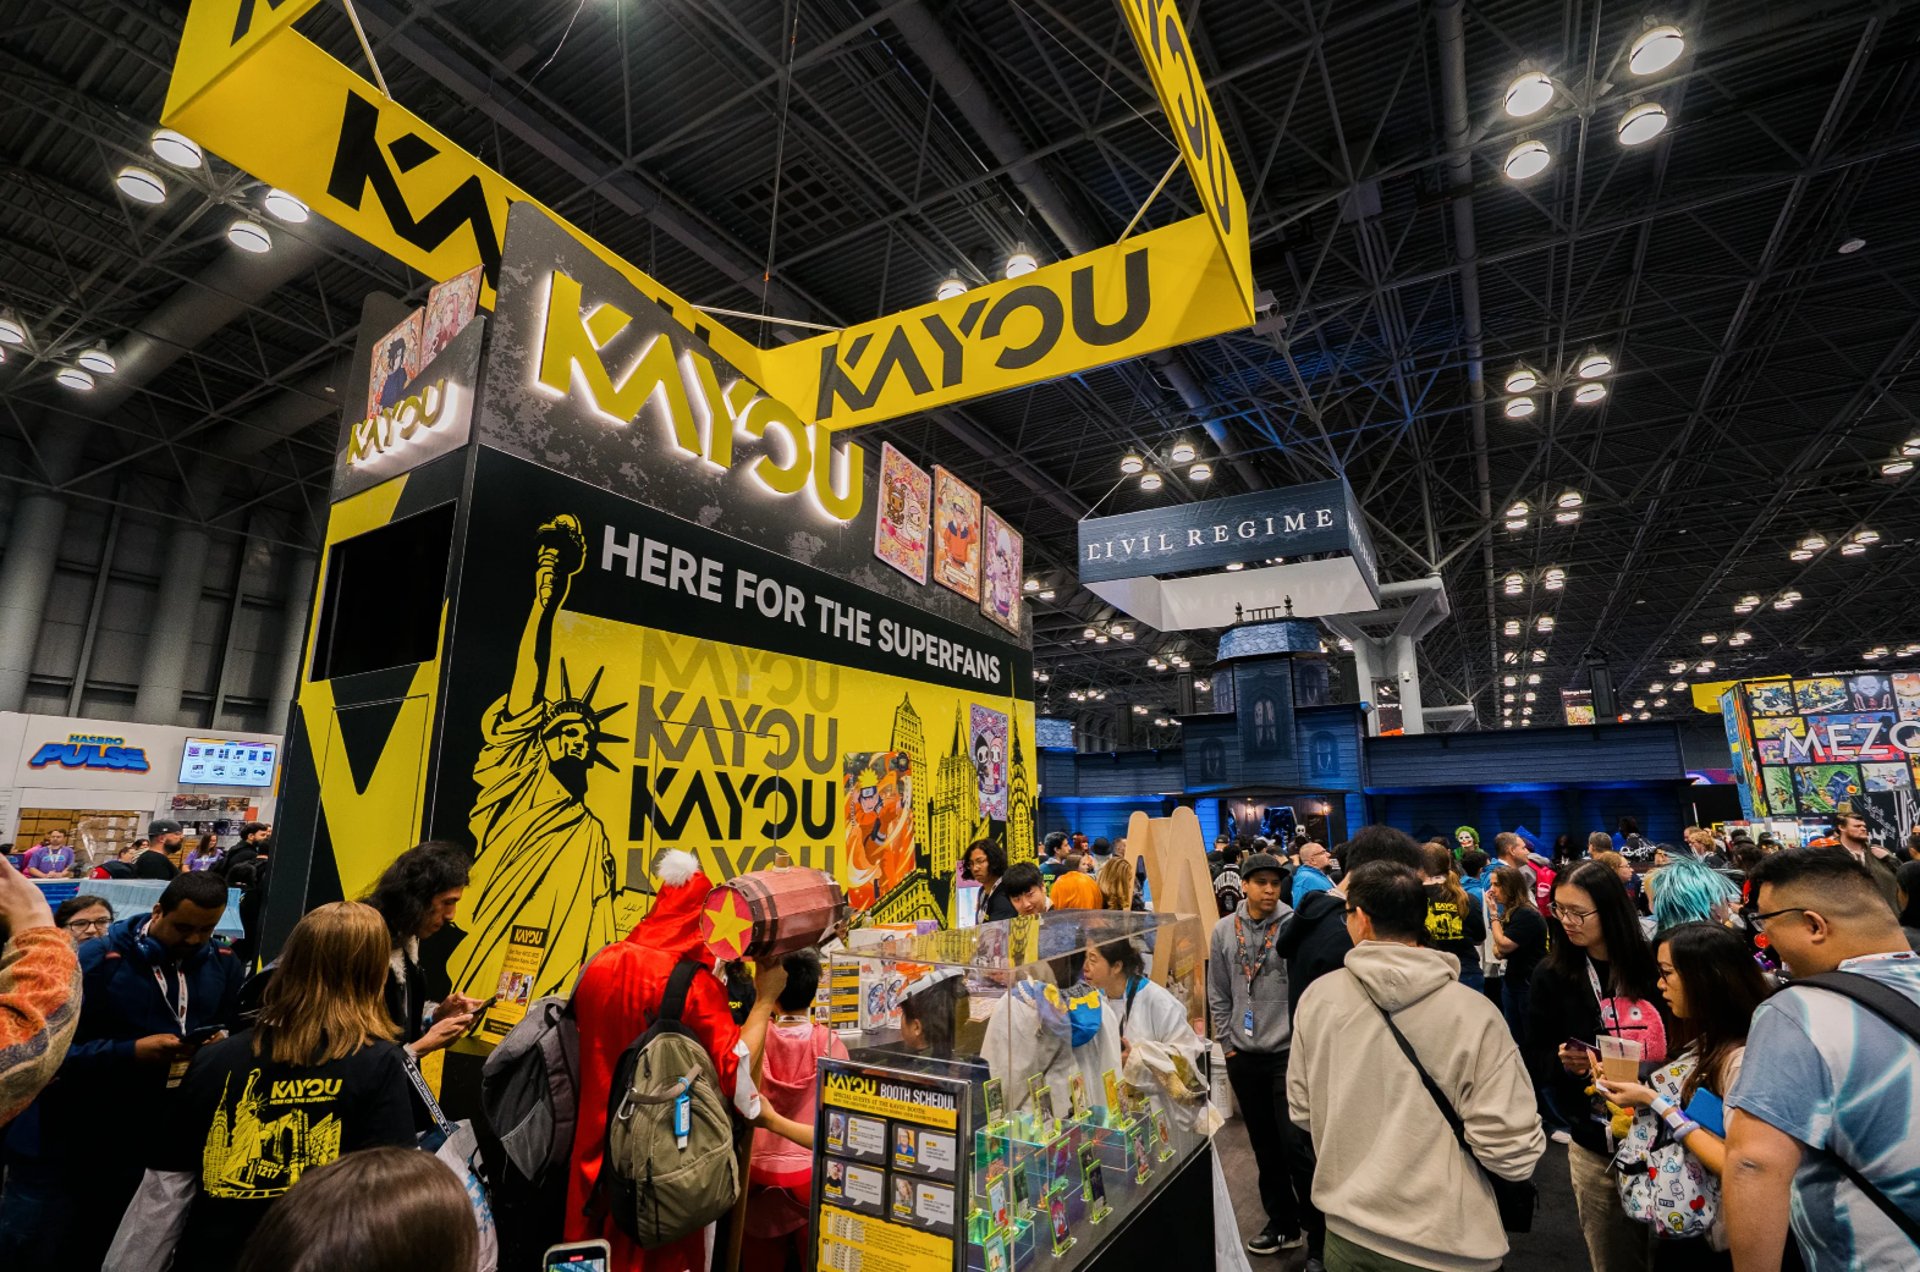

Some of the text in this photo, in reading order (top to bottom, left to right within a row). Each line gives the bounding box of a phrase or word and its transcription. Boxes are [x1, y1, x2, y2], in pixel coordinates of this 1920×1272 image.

[816, 247, 1150, 421] KAYOU
[540, 270, 864, 521] KAYOU
[346, 378, 445, 465] KAYOU
[1187, 508, 1334, 547] REGIME
[601, 525, 1001, 684] HERE FOR THE SUPERFANS
[68, 734, 125, 745] HASBRO
[634, 684, 838, 775] KAYOU
[29, 743, 150, 771] PULSE
[628, 765, 836, 841] KAYOU
[514, 929, 543, 945] KAYOU
[271, 1079, 343, 1098] KAYOU
[827, 1072, 877, 1096] KAYOU
[880, 1083, 910, 1103] BOOTH
[257, 1165, 280, 1179] 1217
